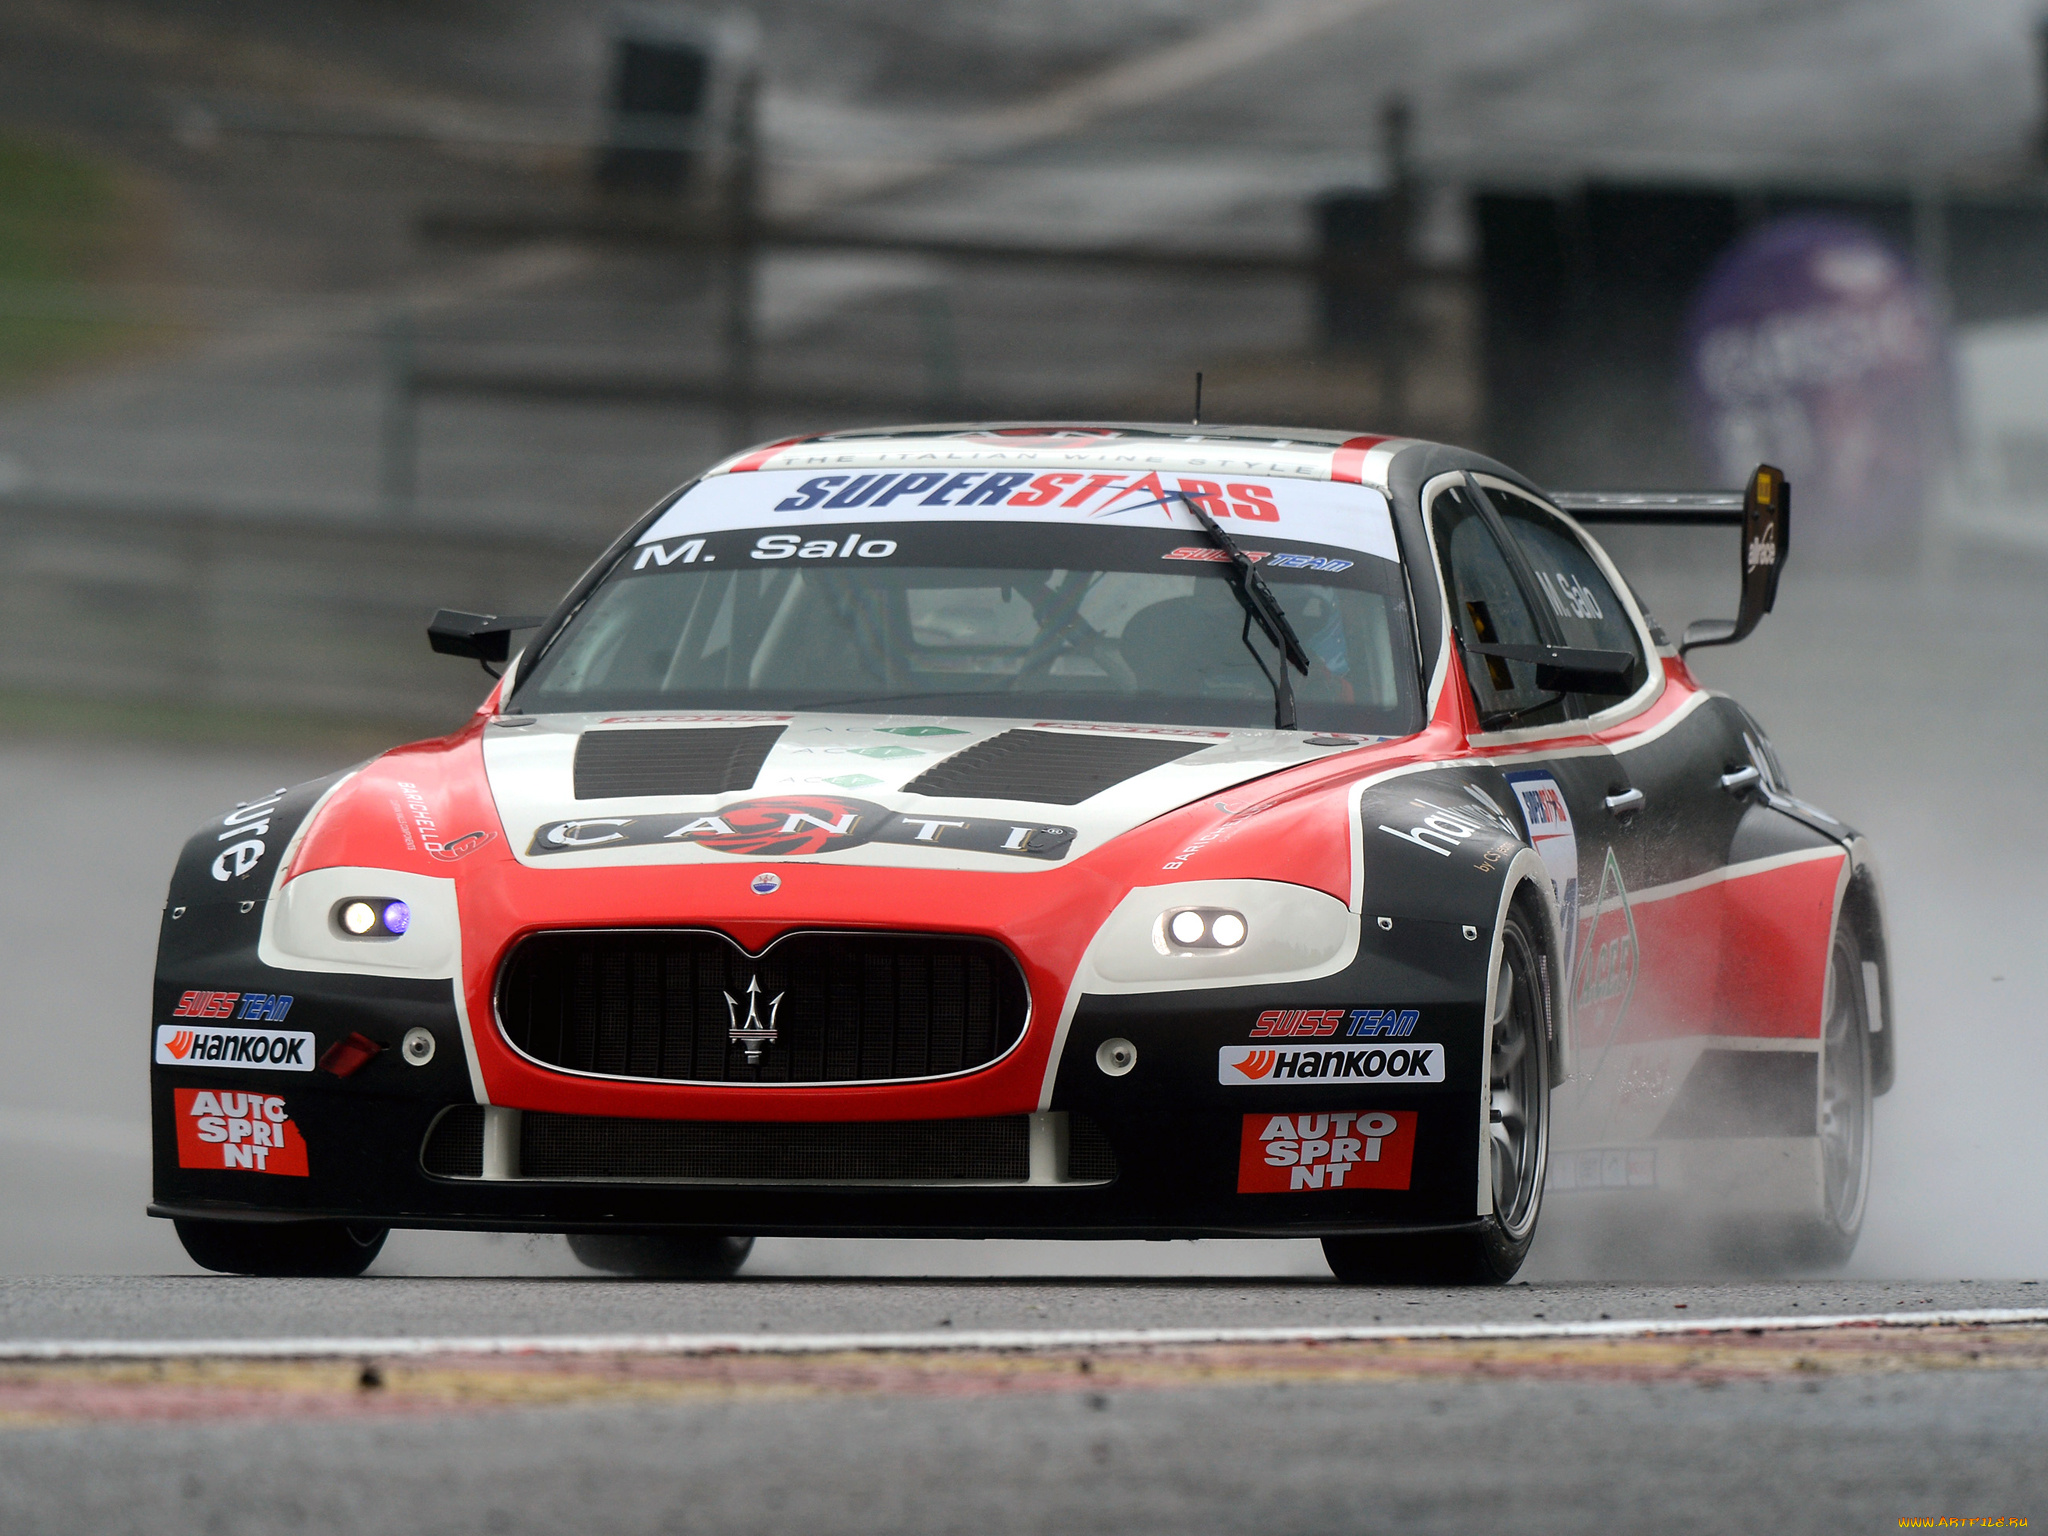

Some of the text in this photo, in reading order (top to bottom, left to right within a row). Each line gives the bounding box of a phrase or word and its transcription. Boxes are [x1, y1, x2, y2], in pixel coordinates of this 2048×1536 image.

[783, 452, 1317, 476] THE ITALIAN WINE STYLE
[774, 470, 1280, 523] SUPERSTARS
[633, 533, 898, 571] M. Salo
[1267, 552, 1354, 573] TEAM
[1535, 571, 1603, 619] M. Salo
[397, 781, 444, 852] BARICHELLO
[547, 813, 1040, 851] CANTI
[173, 990, 294, 1022] SWISS TEAM
[1249, 1009, 1420, 1037] SWISS TEAM
[197, 1116, 285, 1149] SPRI
[1258, 1112, 1398, 1141] AUTO
[223, 1143, 269, 1171] NT
[1263, 1137, 1382, 1167] SPRI
[1289, 1162, 1352, 1190] NT
